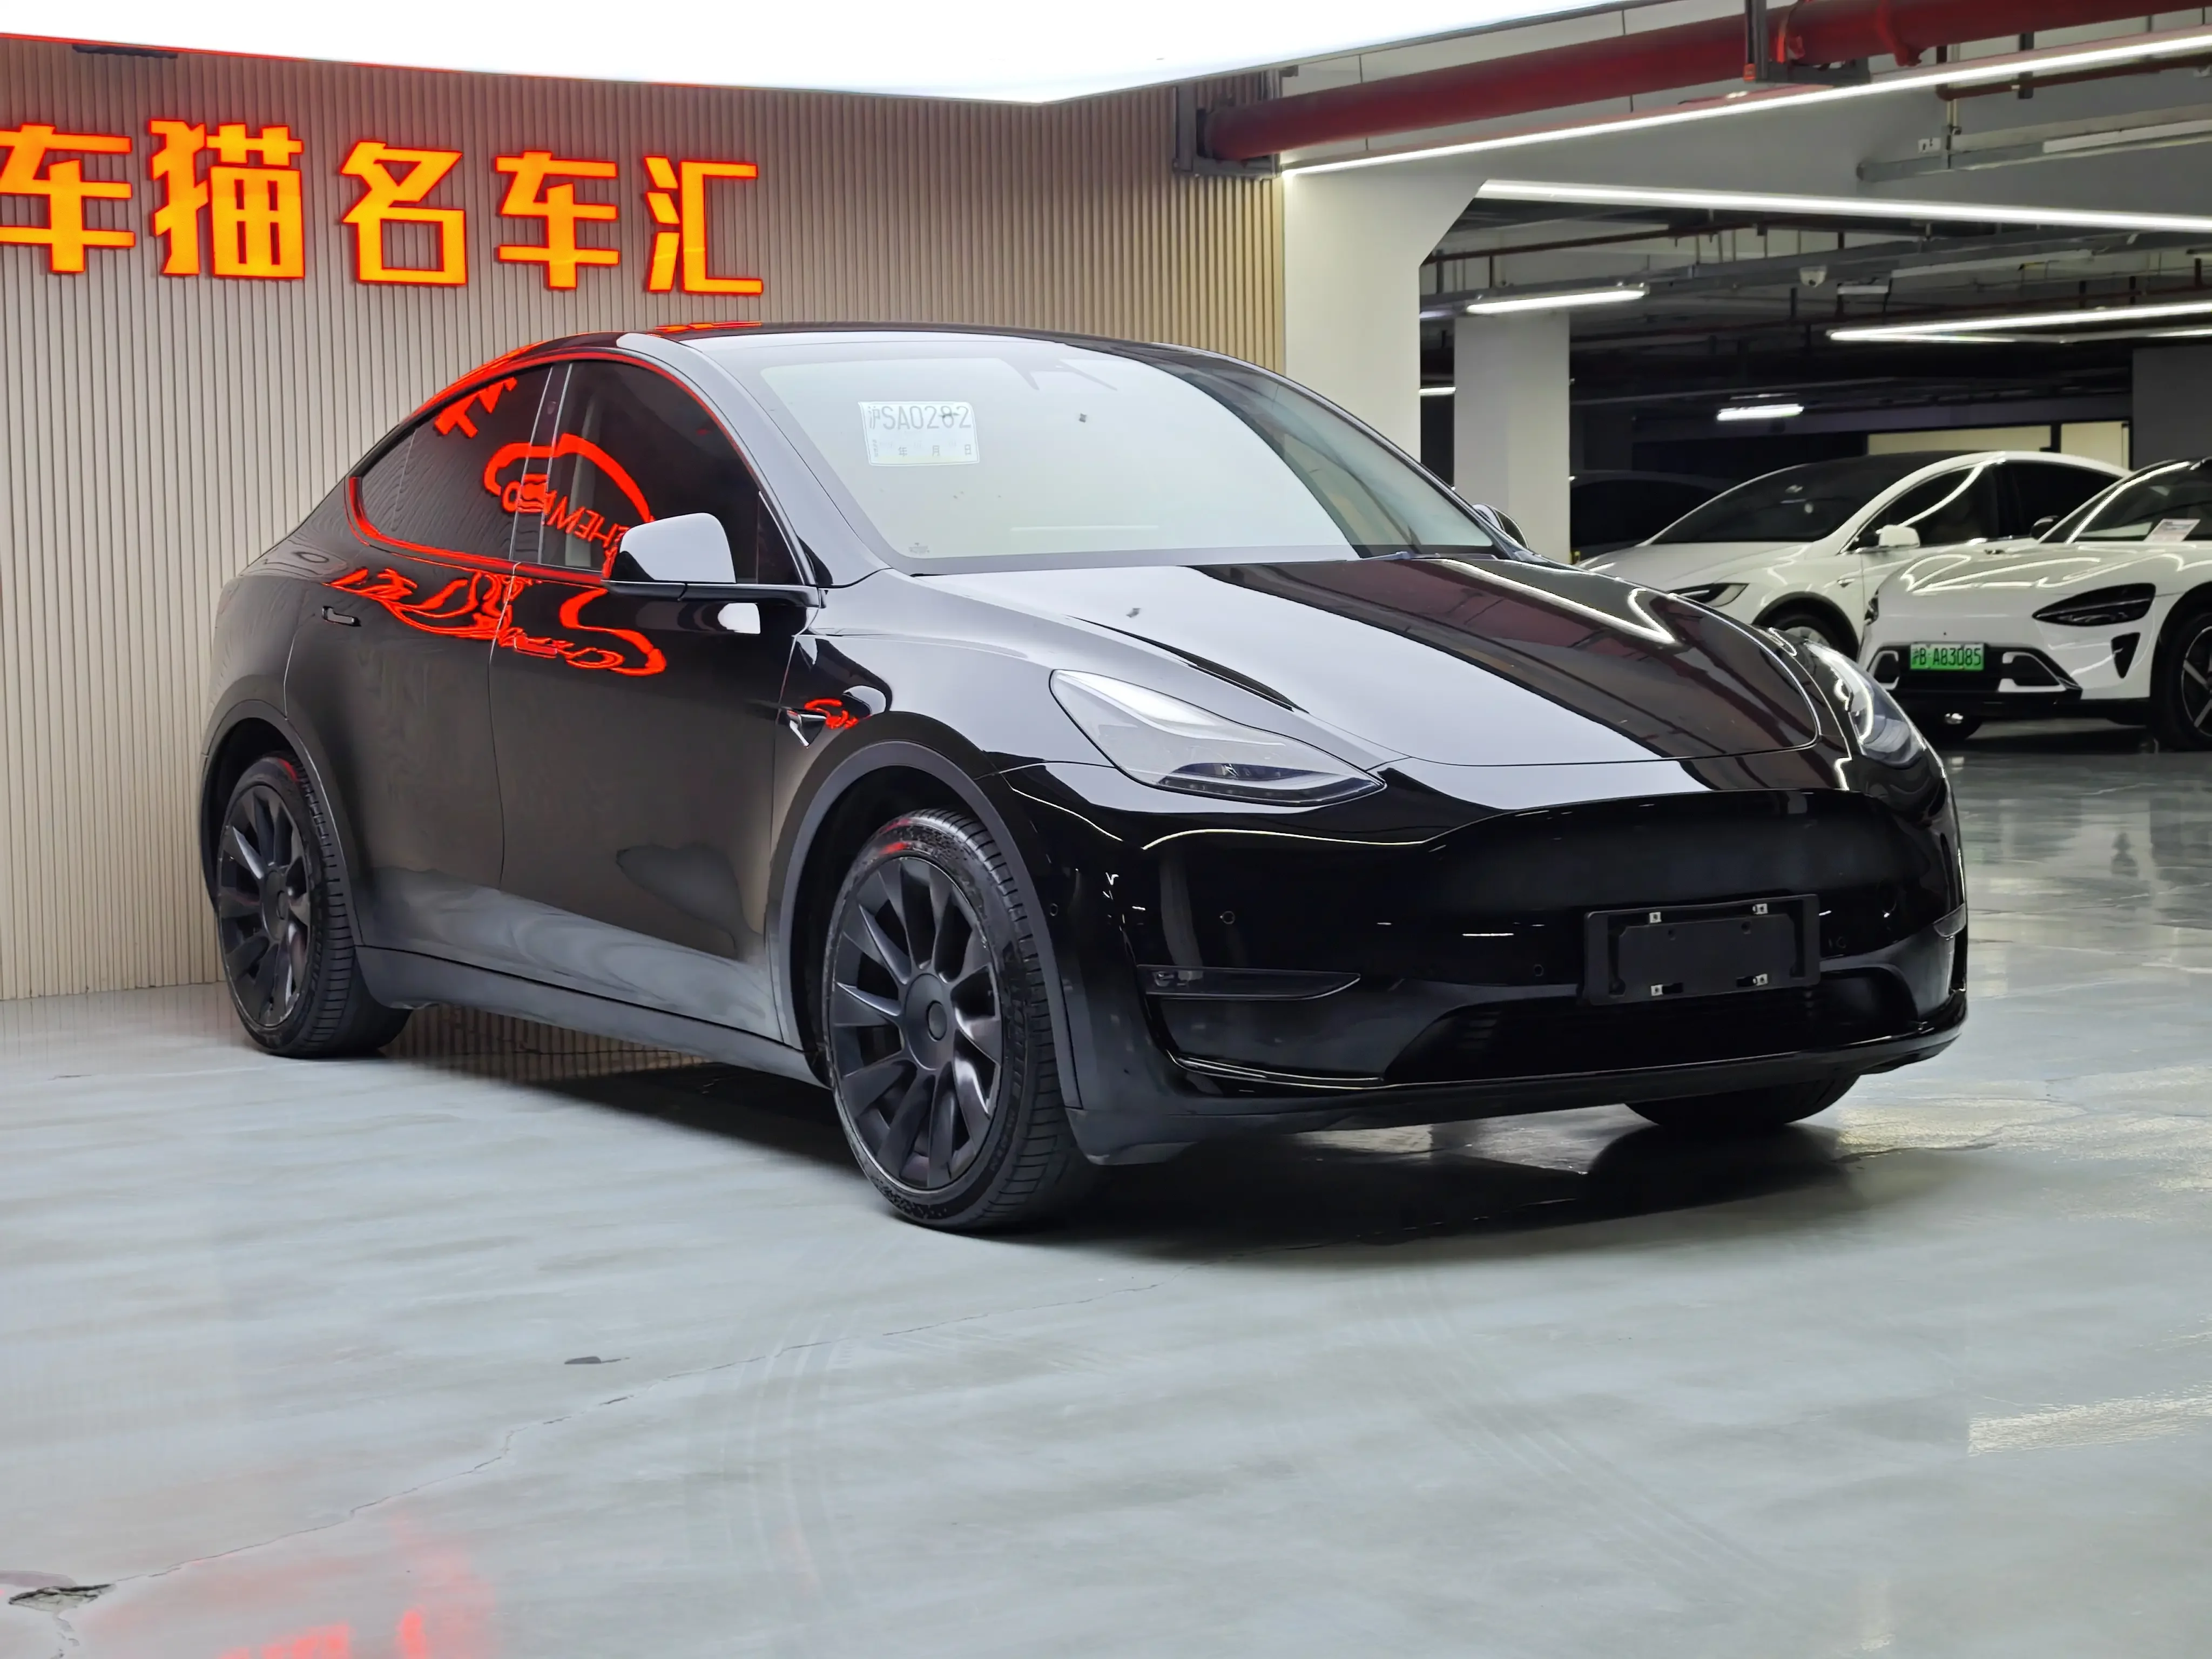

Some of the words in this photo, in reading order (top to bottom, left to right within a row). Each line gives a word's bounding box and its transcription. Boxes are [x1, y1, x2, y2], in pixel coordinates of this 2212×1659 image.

[0, 119, 763, 295] 车猫名车汇
